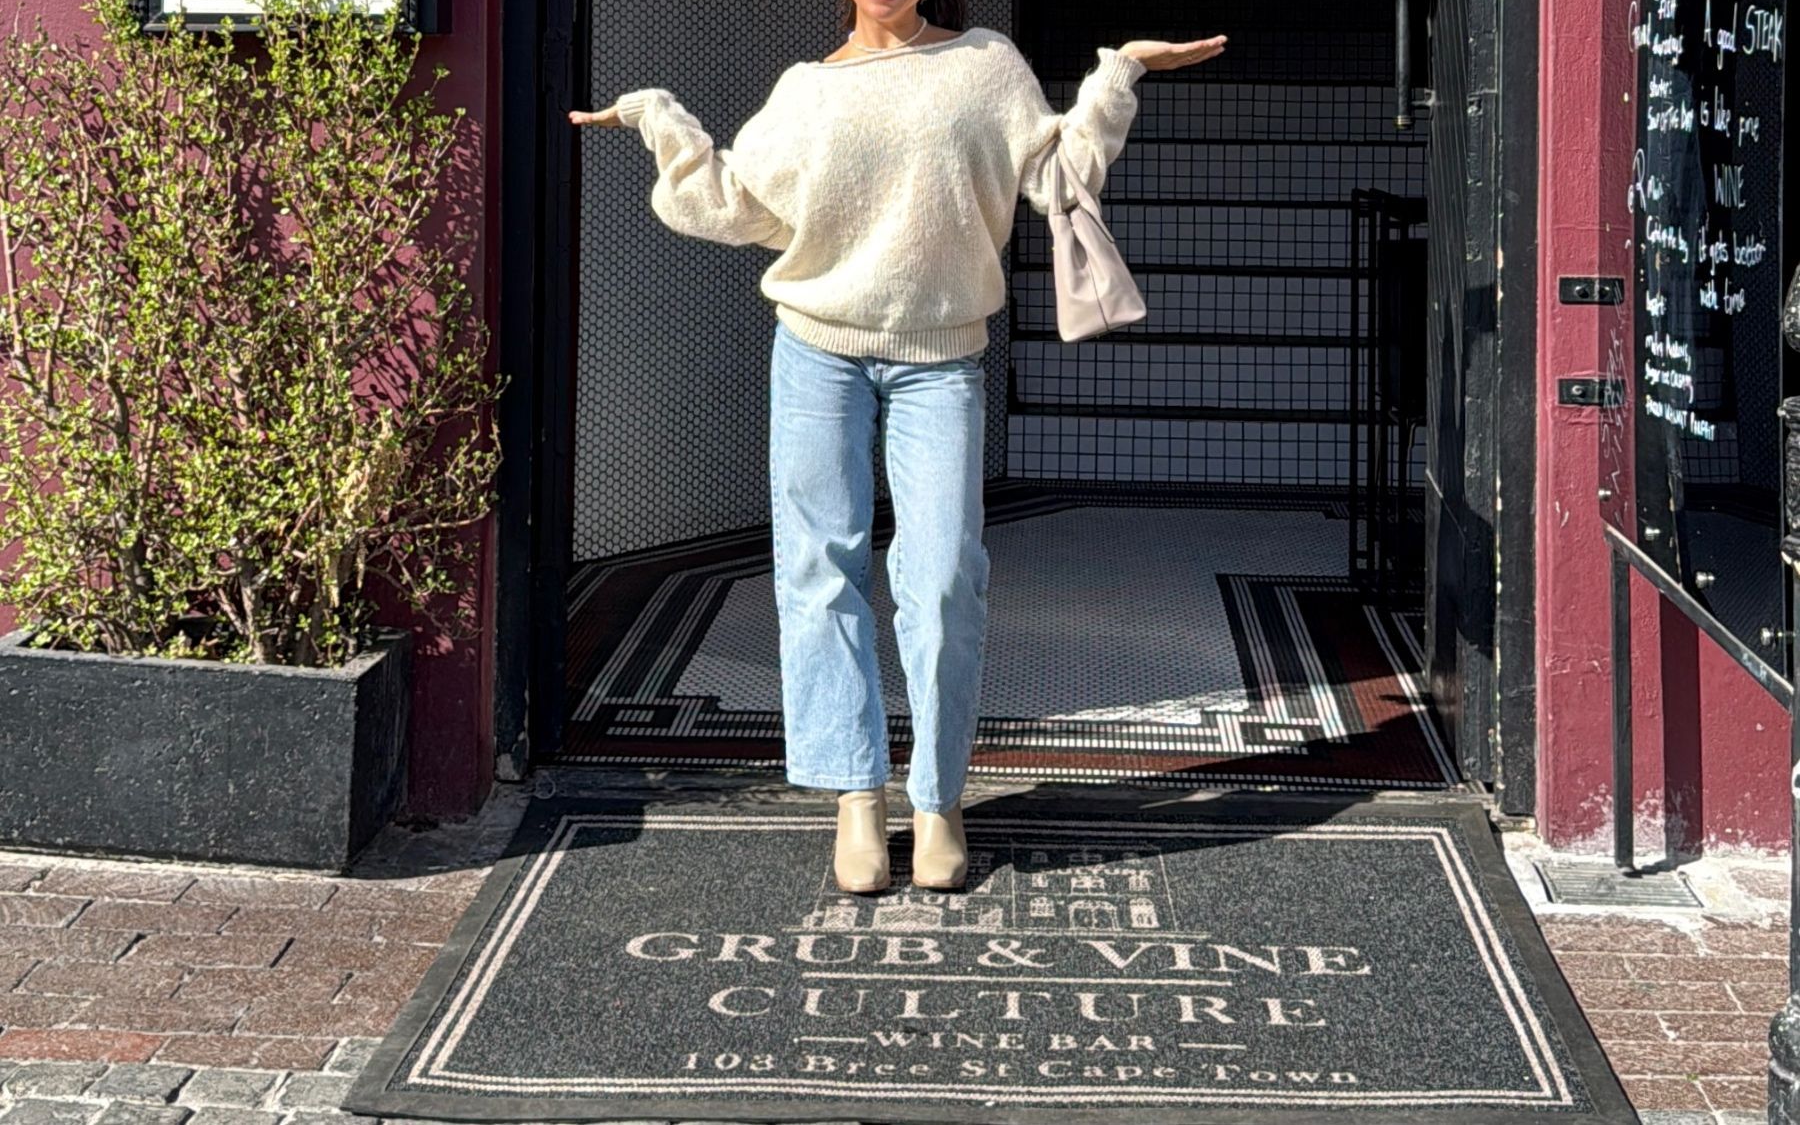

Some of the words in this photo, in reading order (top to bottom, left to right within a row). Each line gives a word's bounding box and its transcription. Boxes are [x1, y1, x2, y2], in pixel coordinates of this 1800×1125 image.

[1717, 1, 1738, 71] good
[1742, 3, 1784, 63] STEAK
[1714, 84, 1732, 139] like
[1713, 162, 1747, 210] WINE
[1710, 228, 1729, 276] gets
[1732, 230, 1767, 268] better
[1723, 276, 1746, 316] time
[624, 931, 946, 966] GRUB
[975, 937, 1056, 969] &
[1077, 939, 1373, 976] VINE
[706, 985, 1328, 1028] CULTURE
[870, 1029, 1026, 1051] WINE
[1047, 1033, 1157, 1052] BAR
[681, 1050, 775, 1072] 103
[799, 1054, 931, 1077] Bree
[959, 1058, 1018, 1078] St
[1037, 1059, 1178, 1082] Cape
[1202, 1063, 1360, 1085] Town
